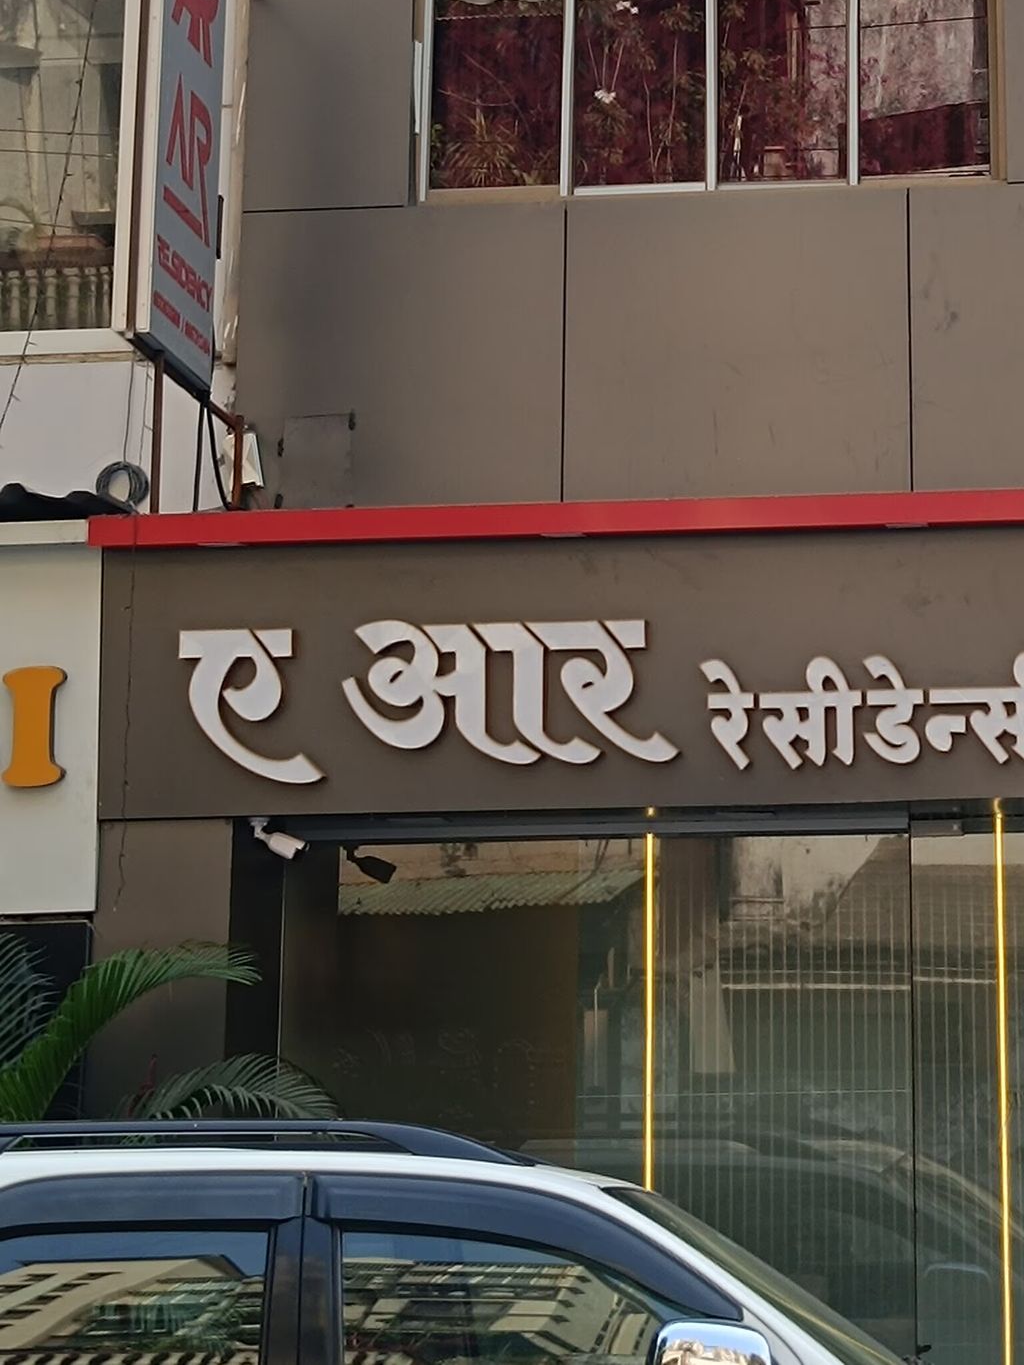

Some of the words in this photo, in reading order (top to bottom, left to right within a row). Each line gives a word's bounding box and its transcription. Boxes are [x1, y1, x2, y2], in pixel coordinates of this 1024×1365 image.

[165, 71, 212, 248] AR
[178, 628, 328, 784] ए
[341, 619, 680, 765] आर
